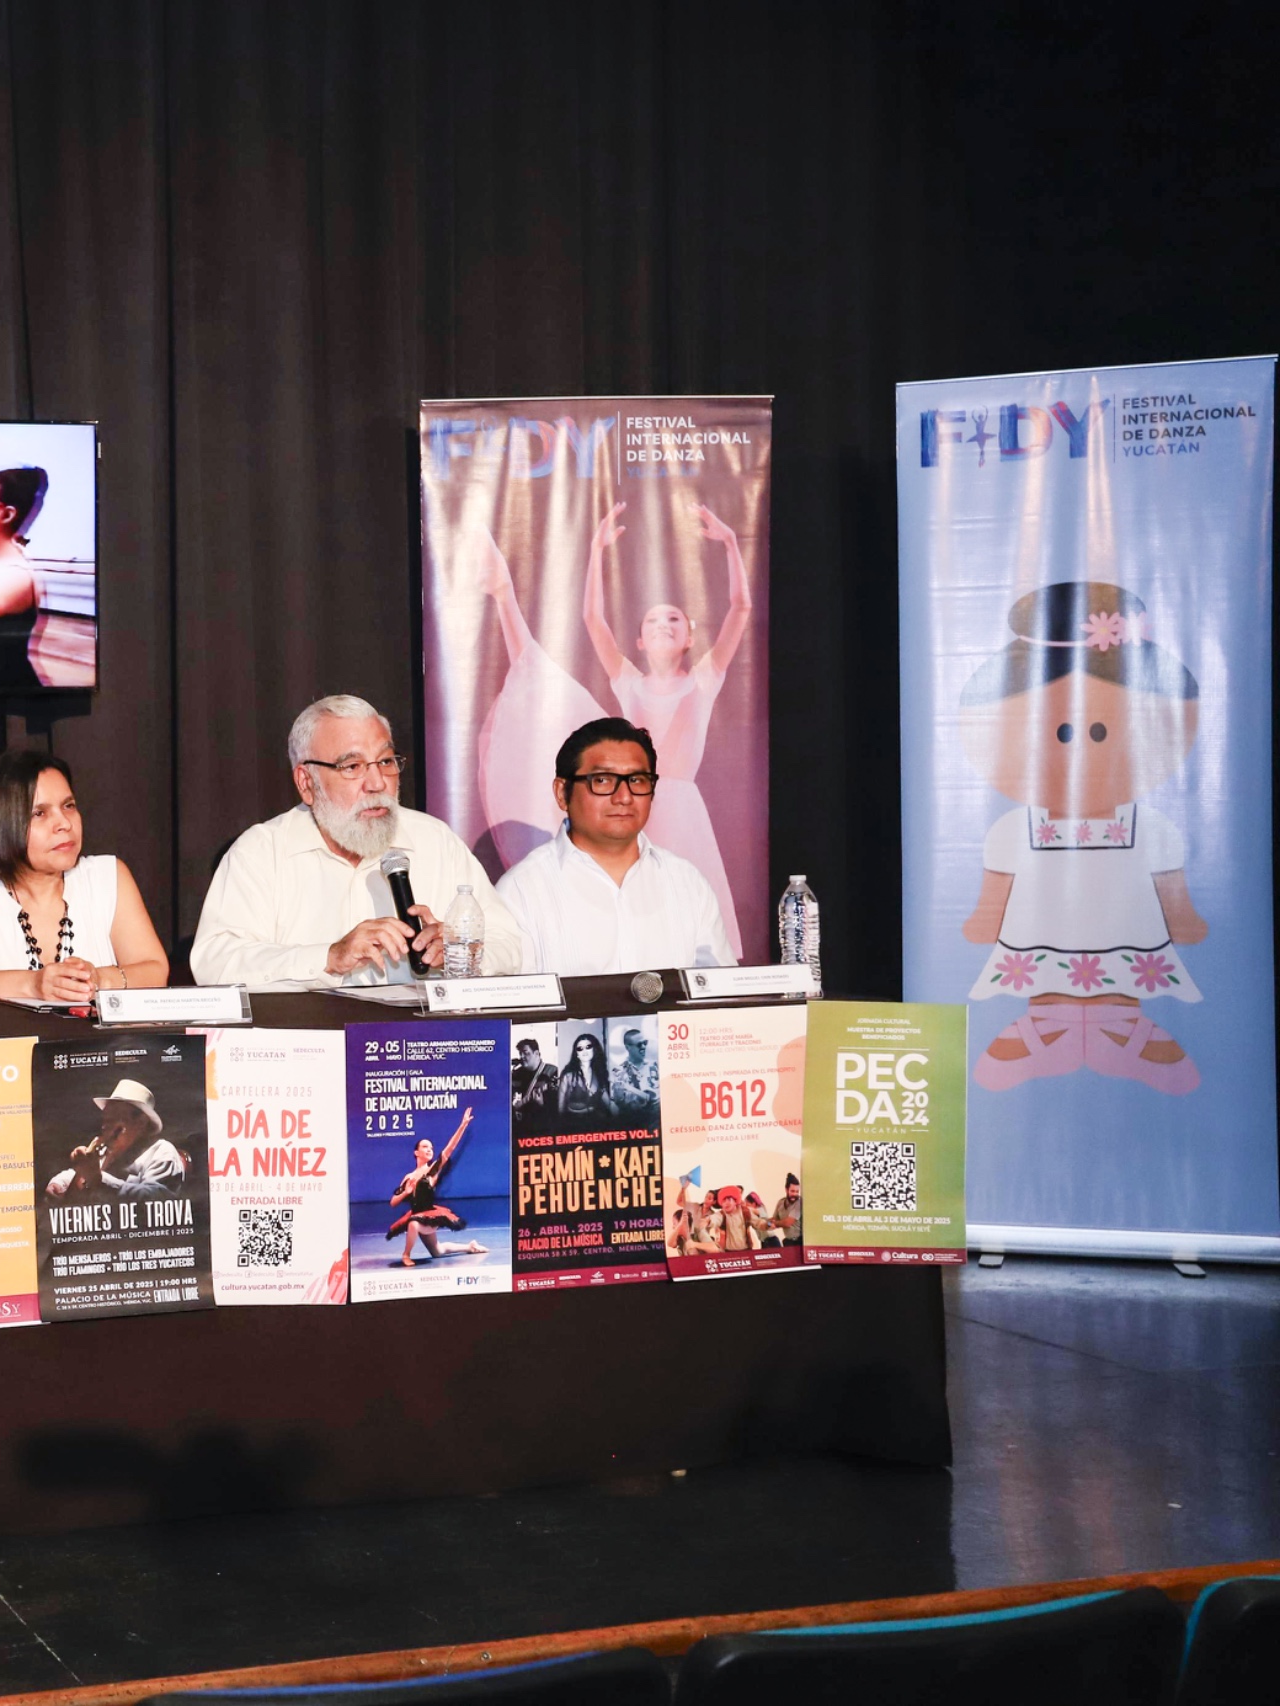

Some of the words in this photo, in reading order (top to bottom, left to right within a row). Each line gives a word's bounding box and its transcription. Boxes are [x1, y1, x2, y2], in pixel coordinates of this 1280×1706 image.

[1123, 394, 1196, 409] FESTIVAL
[627, 417, 696, 429] FESTIVAL
[1123, 406, 1256, 425] INTERNACIONAL
[627, 432, 751, 445] INTERNACIONAL
[1123, 429, 1145, 441] DE
[1149, 426, 1206, 439] DANZA
[627, 450, 646, 462] DE
[652, 449, 705, 461] DANZA
[1123, 440, 1200, 457] YUCATÁN
[668, 1024, 688, 1040] 30
[667, 1043, 689, 1051] ABRIL
[668, 1052, 690, 1060] 2025
[836, 1052, 929, 1090] PEC
[222, 1086, 280, 1097] CARTELERA
[286, 1087, 312, 1097] 2025
[365, 1078, 408, 1093] FESTIVAL
[411, 1075, 487, 1091] INTERNACIONAL
[365, 1097, 378, 1111] DE
[380, 1096, 411, 1111] DANZA
[414, 1092, 457, 1110] YUCATÁN
[700, 1079, 766, 1119] B612
[901, 1092, 929, 1107] 20
[836, 1090, 900, 1125] DA
[228, 1103, 269, 1139] DÍA
[281, 1109, 311, 1139] DE
[901, 1110, 929, 1126] 24
[670, 1125, 706, 1134] CRÉSSIDA
[737, 1119, 802, 1129] CONTEMPORÁNEA
[518, 1136, 553, 1147] VOCES
[556, 1131, 626, 1144] EMERGENTES
[629, 1130, 658, 1139] VOL.1
[209, 1147, 241, 1177] LA
[253, 1141, 327, 1177] NIÑEZ
[518, 1146, 594, 1185] FERMÍN
[225, 1183, 234, 1192] DE
[240, 1183, 263, 1192] ABRIL
[277, 1183, 281, 1192] 4
[286, 1183, 295, 1192] DE
[301, 1183, 323, 1192] MAYO
[231, 1197, 276, 1205] ENTRADA
[519, 1176, 662, 1216] PEHUENCHE
[49, 1204, 111, 1235] VIERNES
[120, 1203, 138, 1229] DE
[145, 1199, 193, 1227] TROVA
[52, 1235, 98, 1244] TEMPORADA
[129, 1230, 169, 1238] DICIEMBRE
[518, 1229, 530, 1237] 26
[539, 1225, 569, 1235] ABRIL
[578, 1223, 603, 1232] 2025
[614, 1221, 625, 1229] 19
[54, 1286, 86, 1294] VIERNES
[99, 1283, 121, 1291] ABRIL
[221, 1283, 304, 1291] cultura.yucatan.gob.mx
